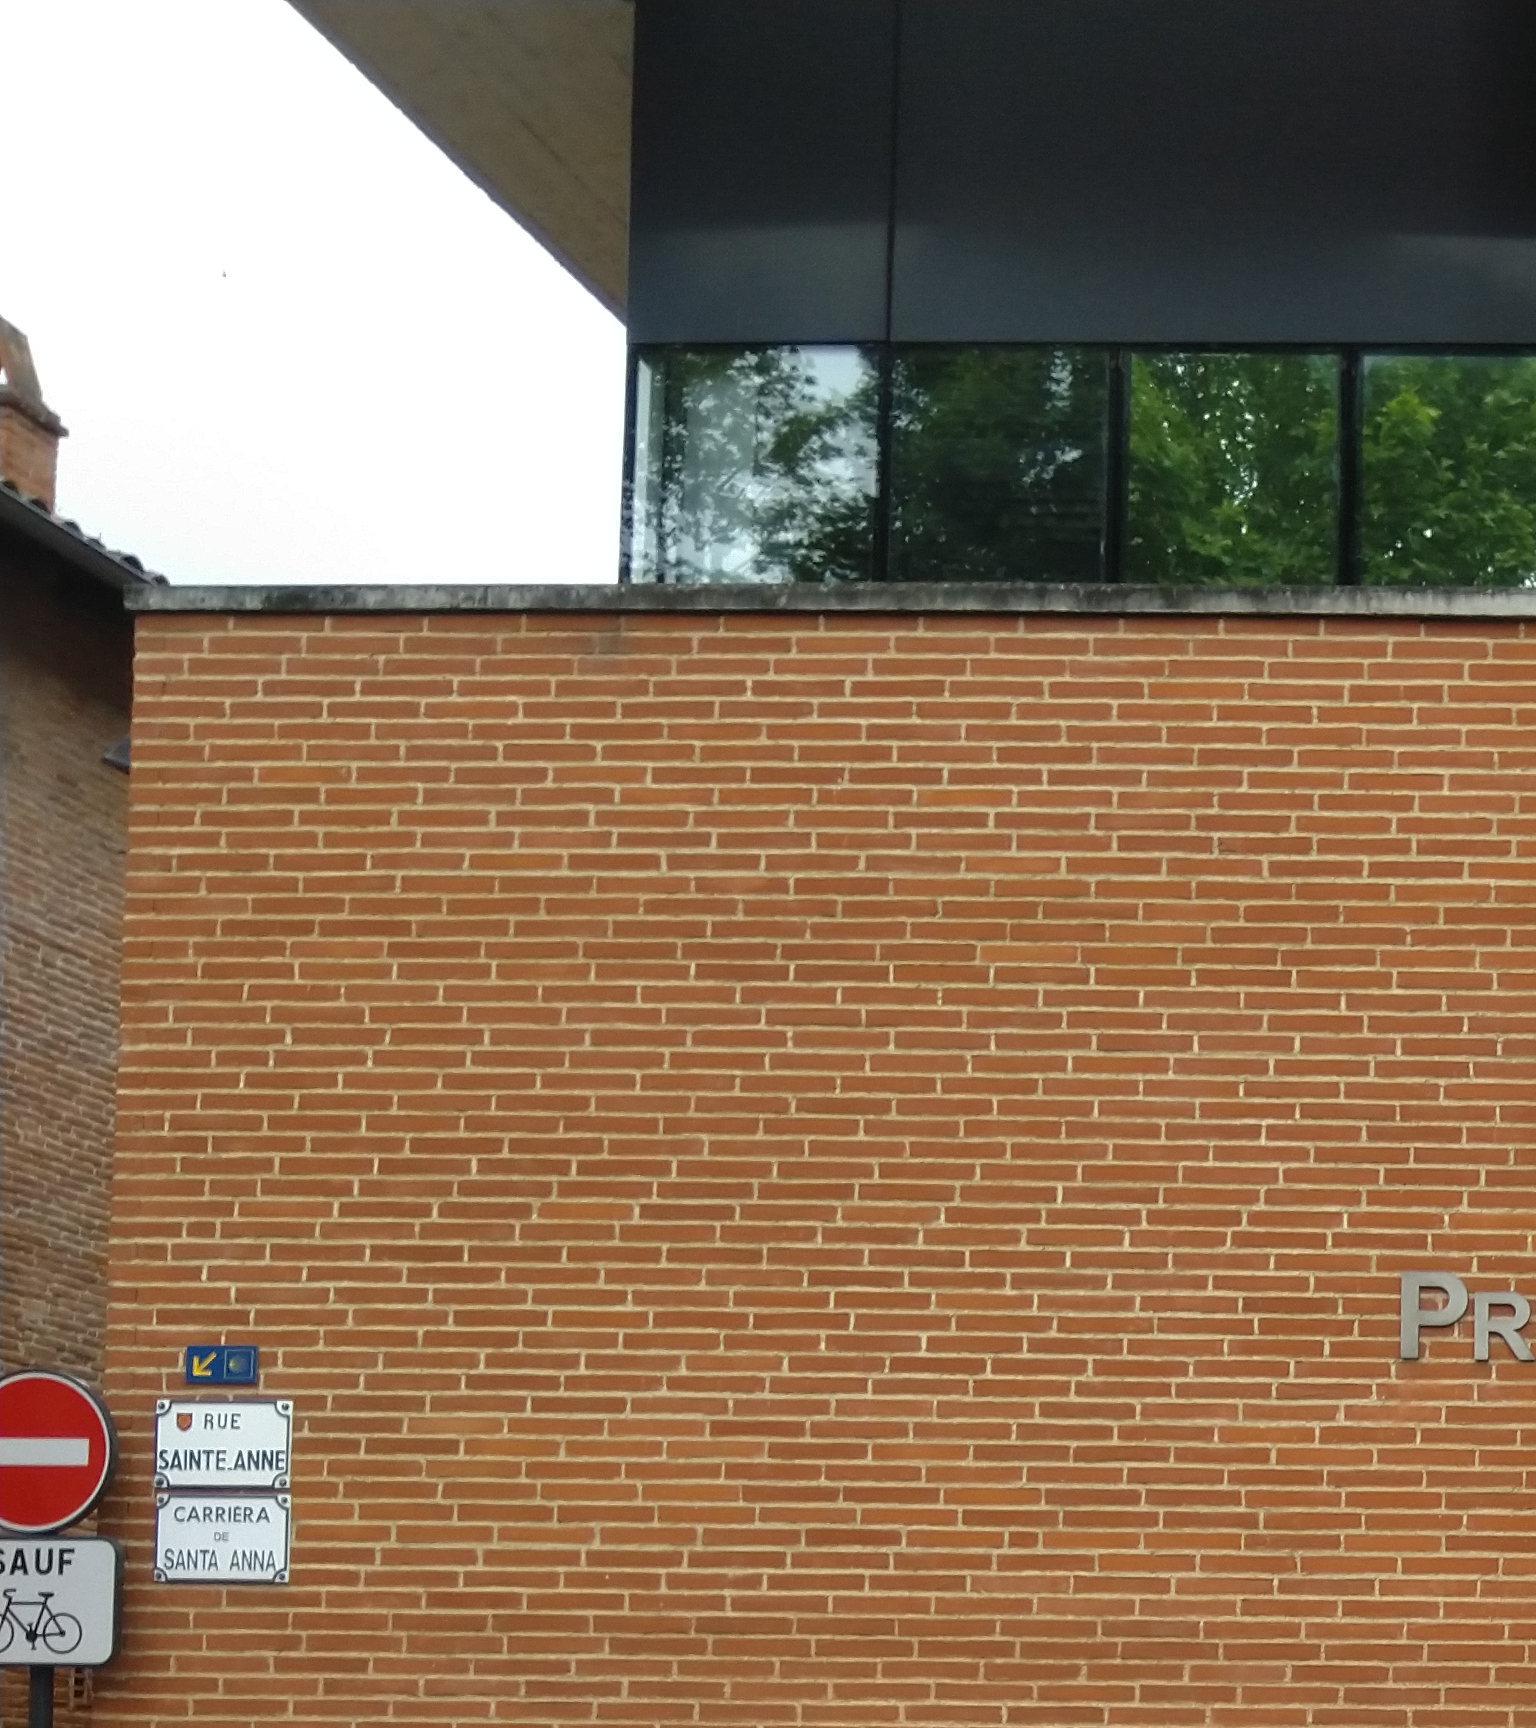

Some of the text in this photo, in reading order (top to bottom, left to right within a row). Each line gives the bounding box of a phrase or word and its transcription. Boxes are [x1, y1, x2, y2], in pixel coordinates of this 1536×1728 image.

[203, 1412, 241, 1430] RUE
[213, 1531, 230, 1541] DE
[164, 1548, 277, 1571] SANTA ANNA
